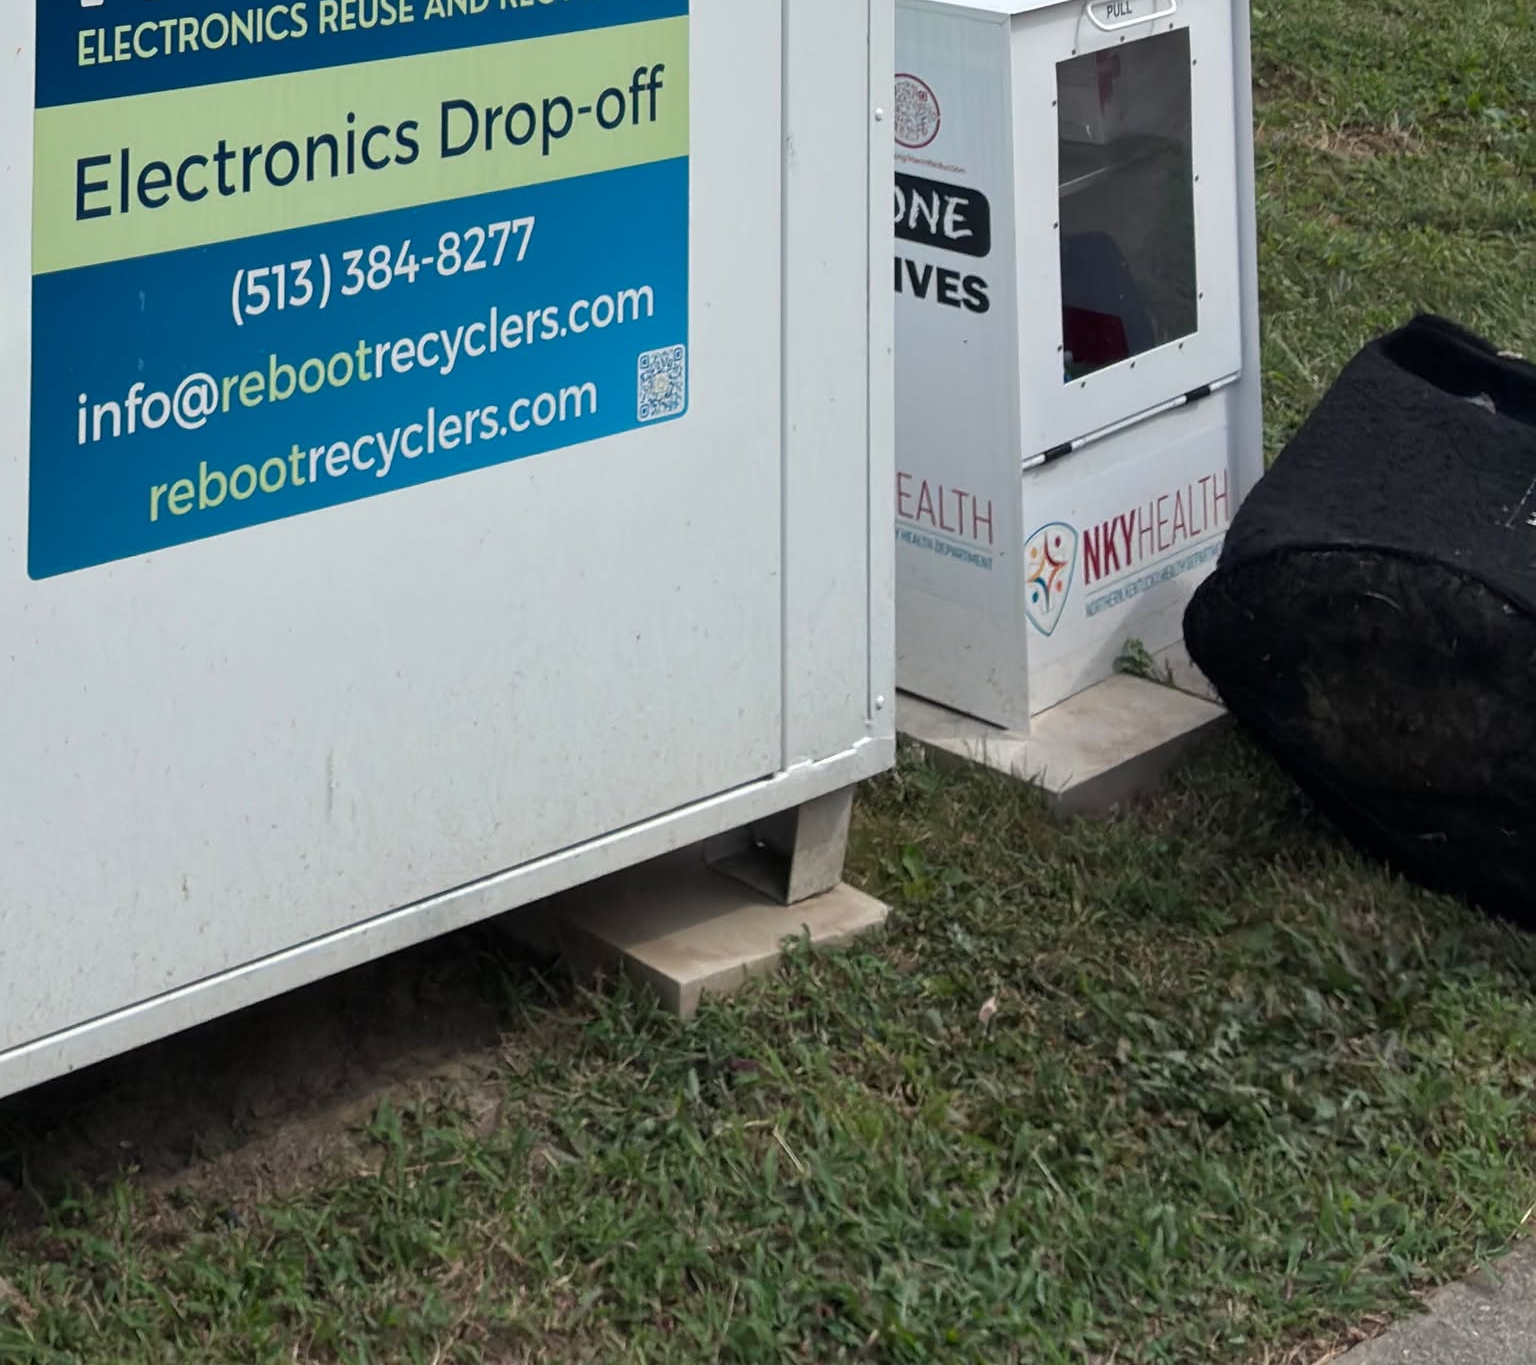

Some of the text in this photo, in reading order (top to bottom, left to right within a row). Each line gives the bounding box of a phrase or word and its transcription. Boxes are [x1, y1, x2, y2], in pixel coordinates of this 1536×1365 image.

[77, 1, 309, 66] ELECTRONICS
[1106, 0, 1132, 19] PULL
[74, 63, 666, 222] Electronics Drop-off
[231, 216, 537, 326] (513) 384-8277
[77, 280, 655, 446] info@rebootrecyclers.com
[149, 376, 598, 522] rebootrecyclers.com
[897, 471, 993, 545] EALTH
[1083, 469, 1230, 586] NKYHEALTH
